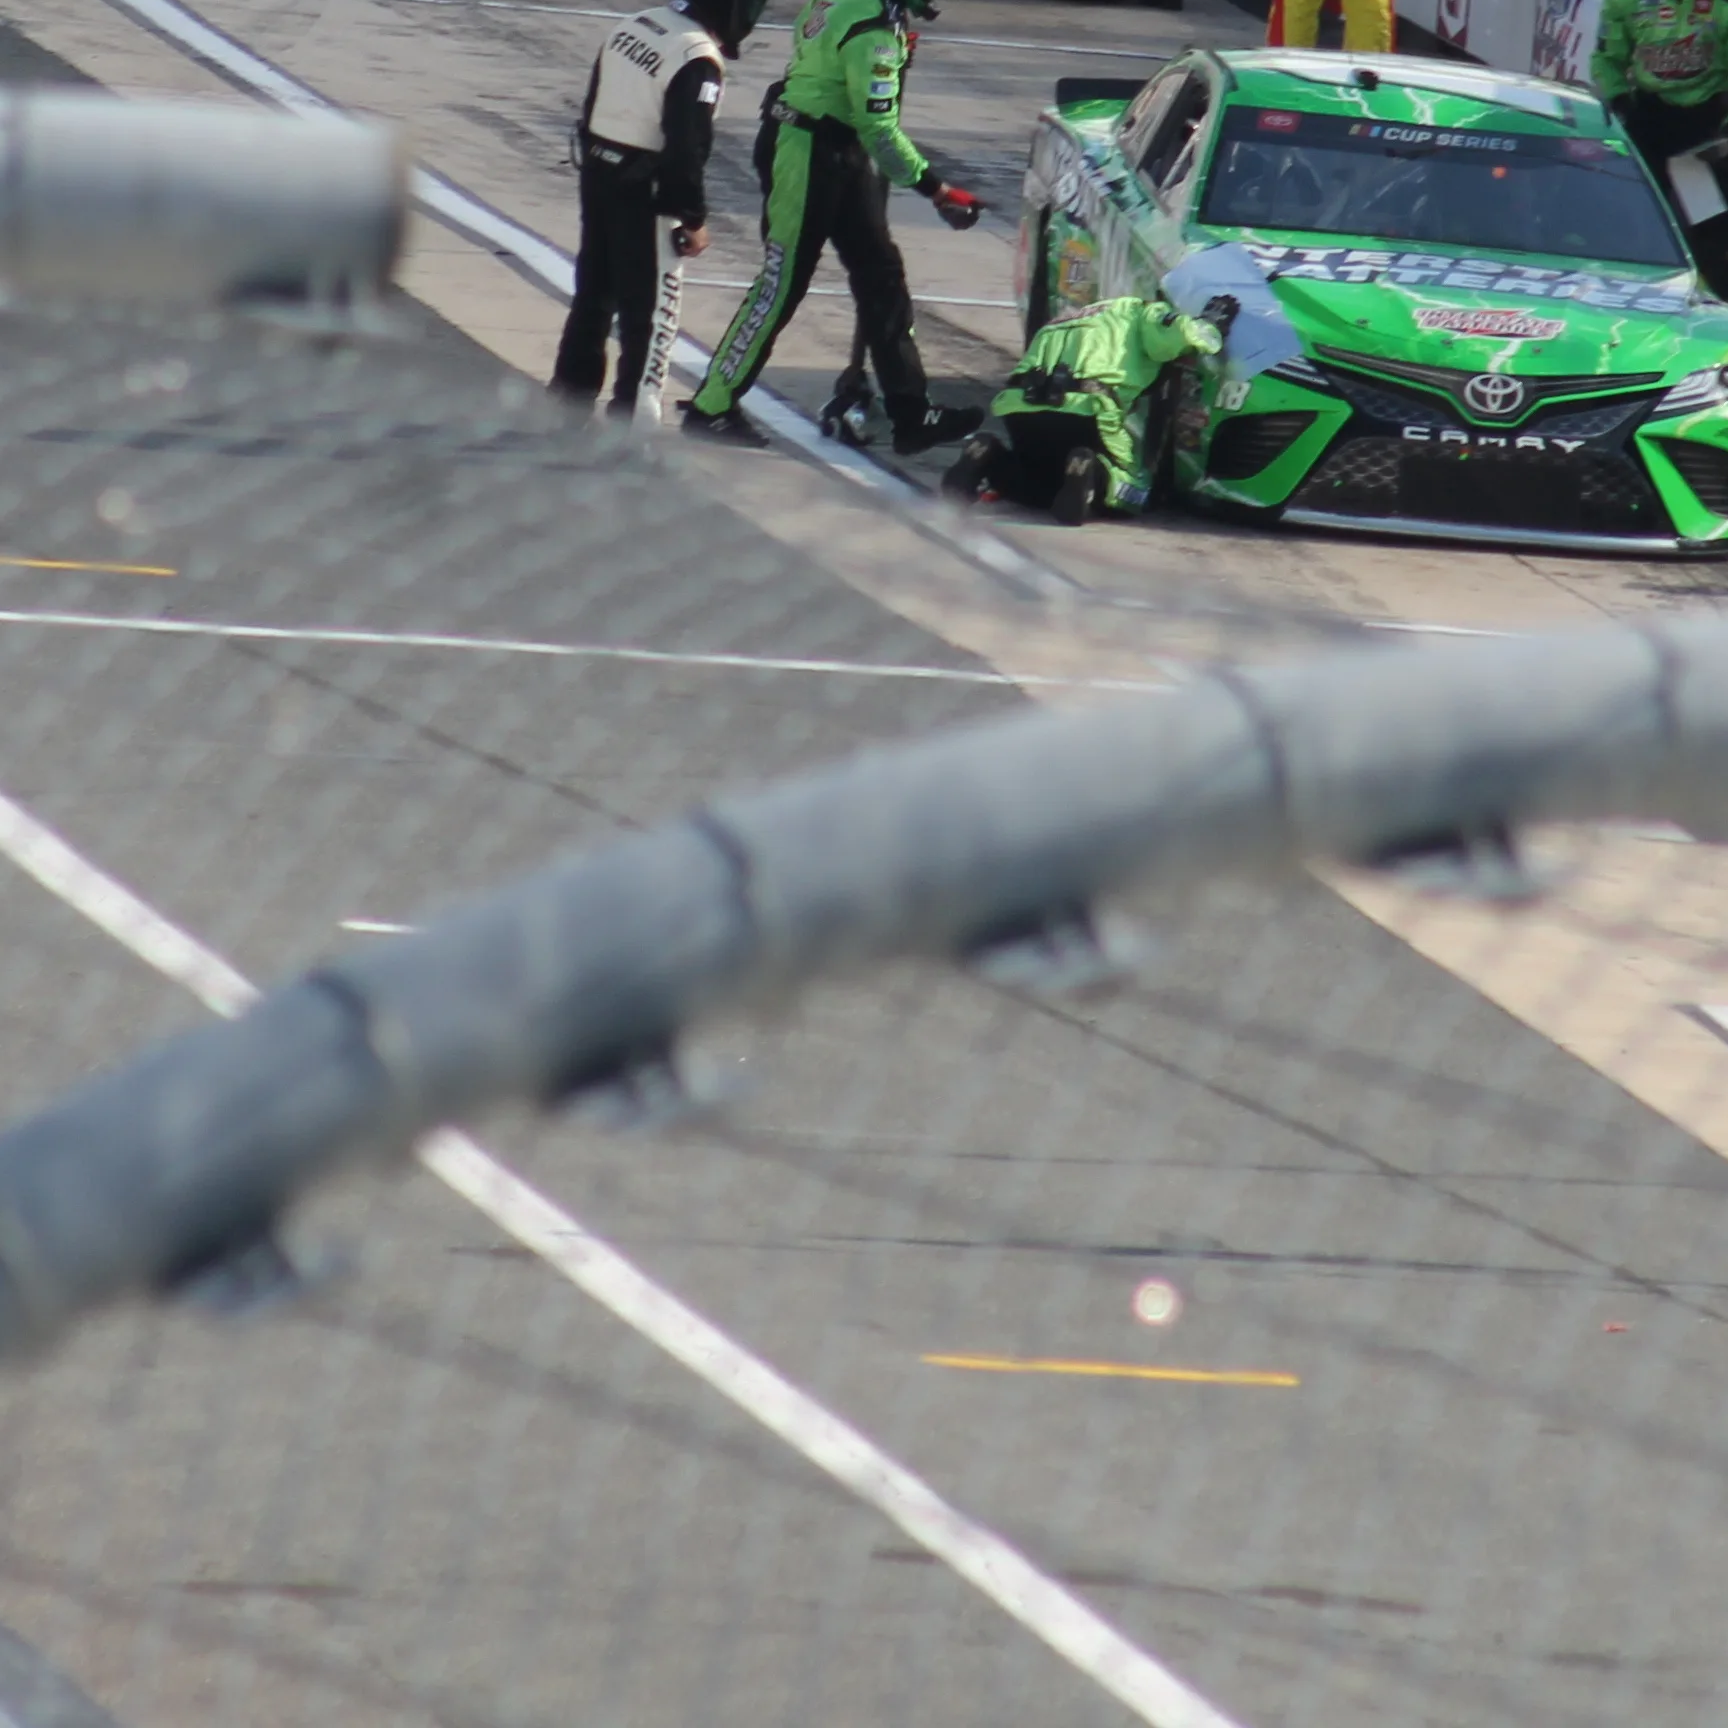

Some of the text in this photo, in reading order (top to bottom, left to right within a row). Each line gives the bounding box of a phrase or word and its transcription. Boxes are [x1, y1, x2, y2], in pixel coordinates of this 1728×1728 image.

[609, 31, 665, 78] FFICIAL
[1382, 127, 1519, 152] CUP SERIES
[1246, 243, 1696, 301] NTERSTATE
[1214, 379, 1252, 412] 18
[1402, 426, 1586, 453] CAMRY
